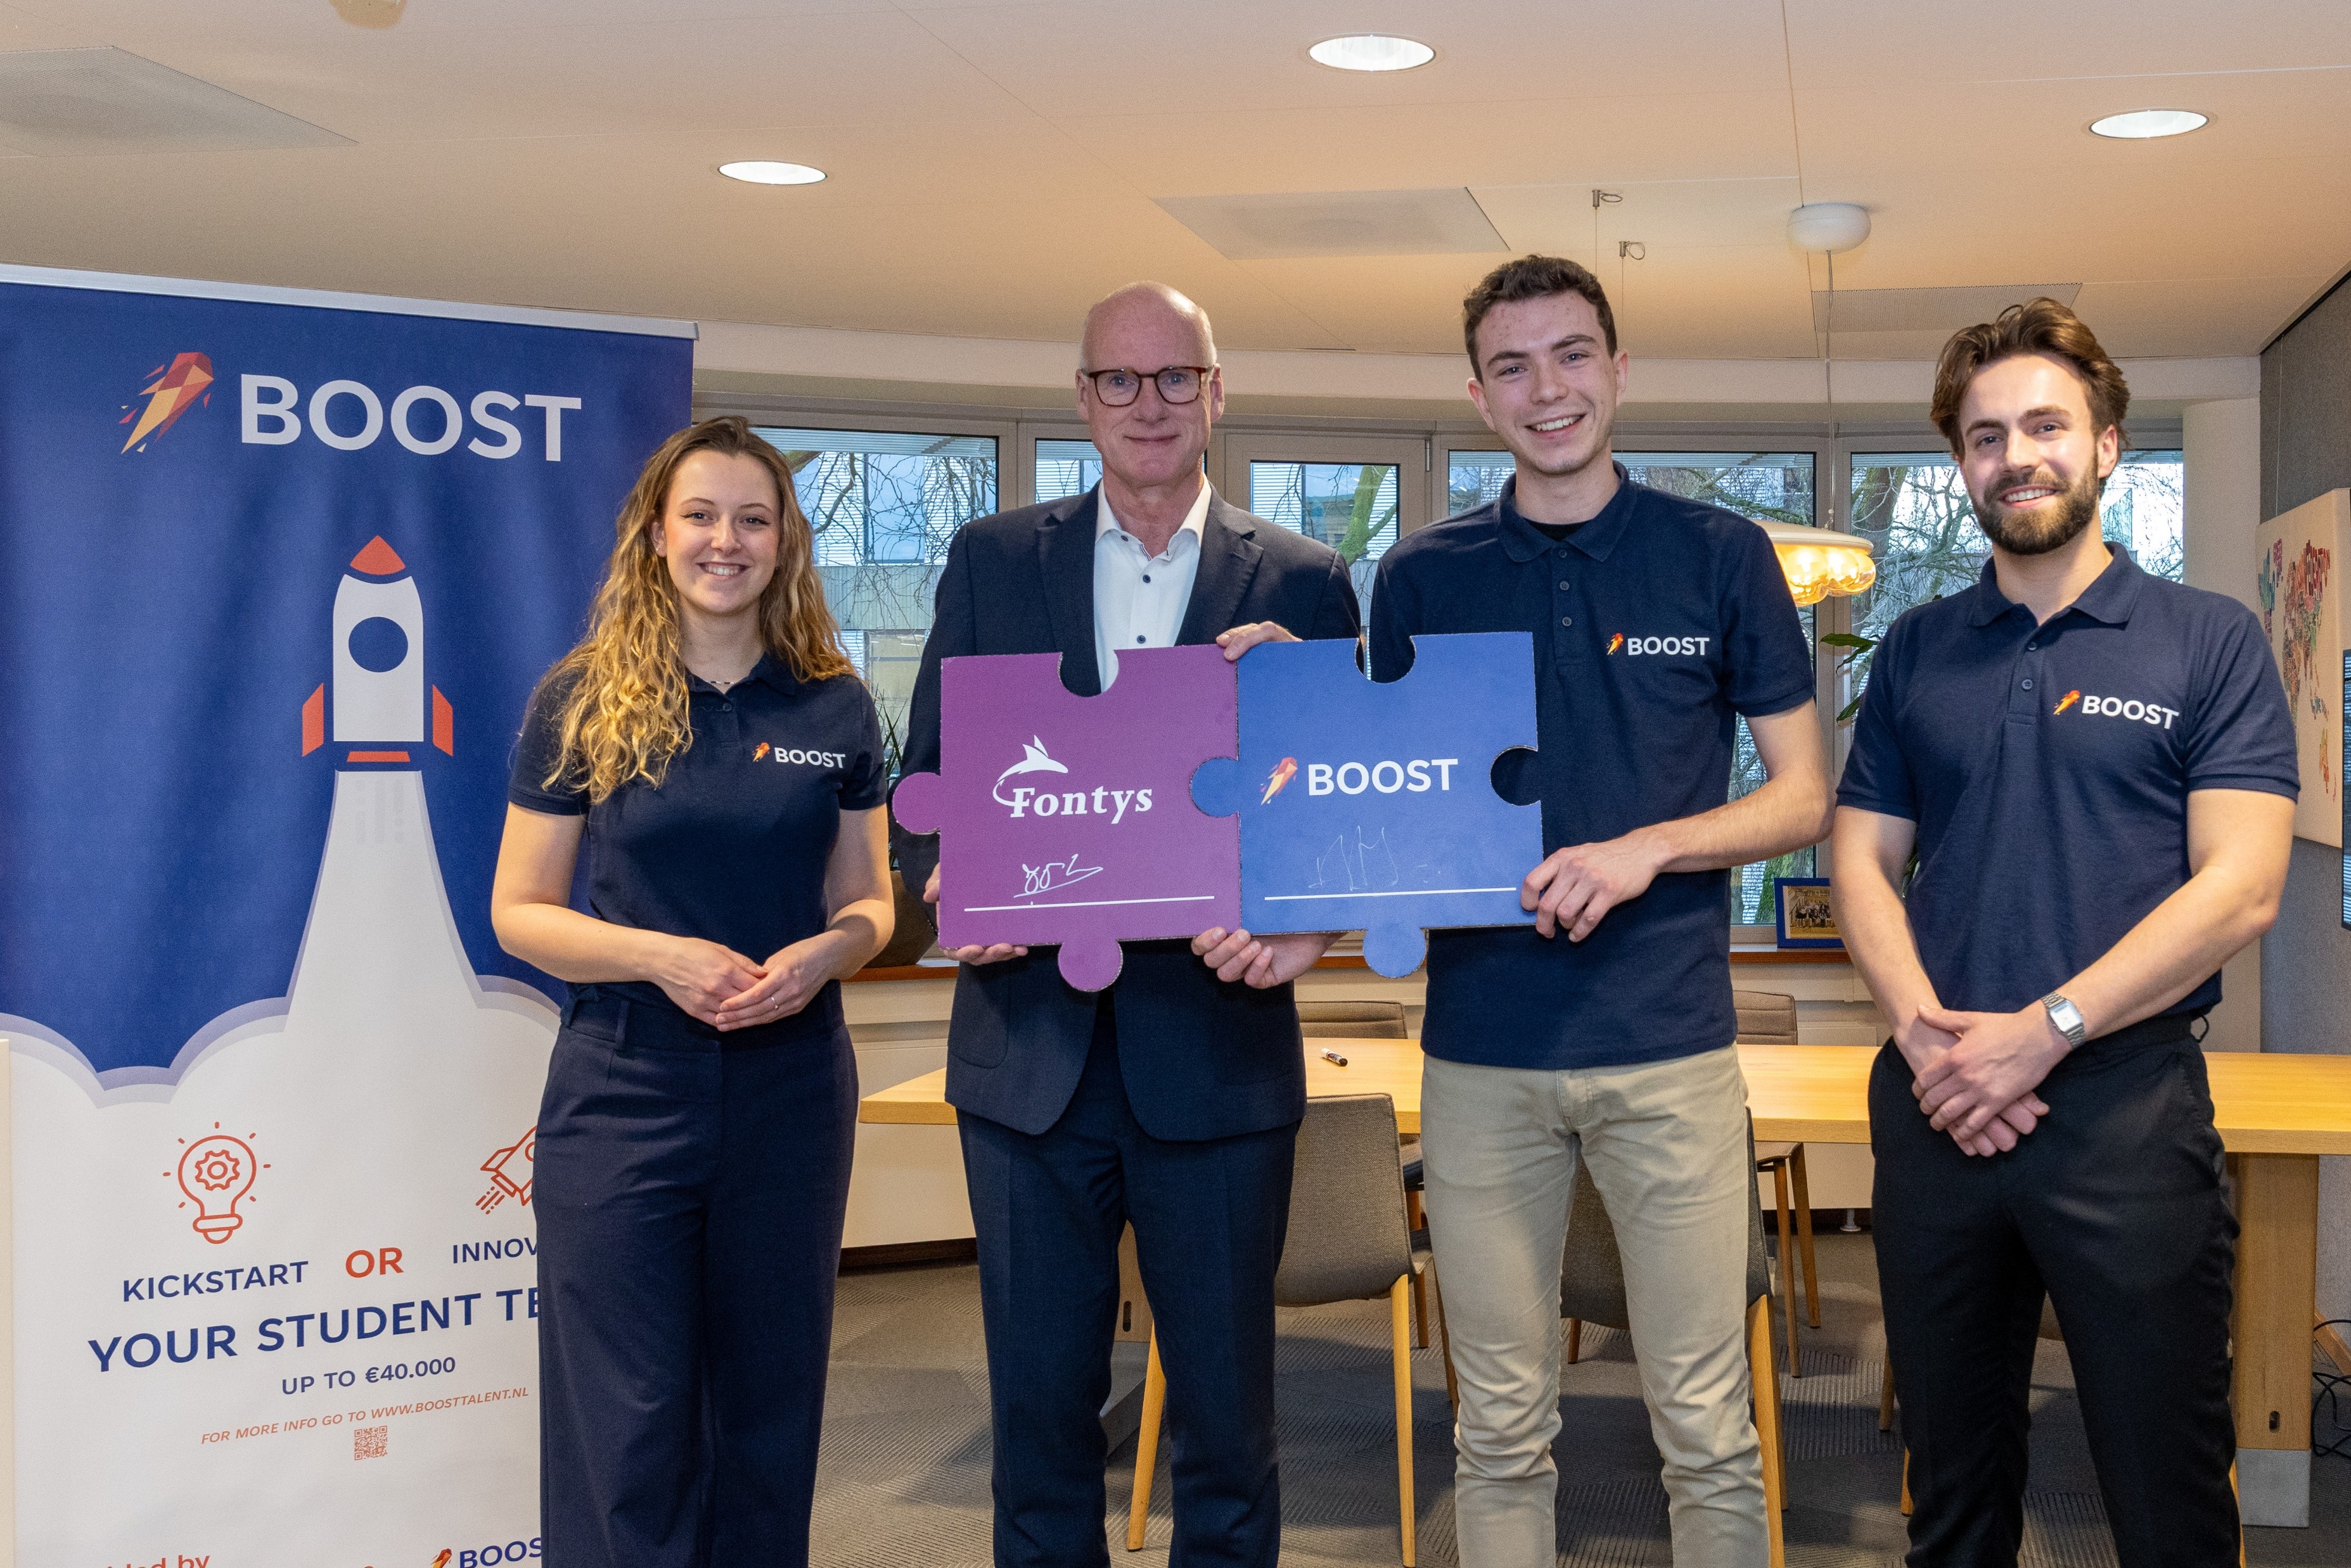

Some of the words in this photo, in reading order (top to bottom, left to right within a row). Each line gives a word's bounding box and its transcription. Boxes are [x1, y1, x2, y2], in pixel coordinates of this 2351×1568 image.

[241, 374, 581, 461] BOOST
[1628, 637, 1709, 655] BOOST
[2082, 696, 2179, 729] BOOST
[774, 748, 845, 768] BOOST
[1309, 759, 1458, 795] BOOST
[1010, 786, 1152, 824] Fontys
[124, 1261, 308, 1302] KICKSTART
[346, 1247, 403, 1278] OR
[454, 1238, 536, 1263] INNOV
[88, 1325, 237, 1372] YOUR
[258, 1293, 481, 1351] STUDENT
[496, 1287, 537, 1320] TE
[283, 1376, 314, 1394] UP
[324, 1370, 355, 1389] TO
[366, 1357, 455, 1383] €40.000
[202, 1431, 230, 1444] FOR
[236, 1424, 278, 1439] MORE
[284, 1418, 317, 1431] INFO
[322, 1414, 343, 1425] GO
[349, 1411, 366, 1422] TO
[371, 1387, 528, 1418] WWW.BOOSTTALENT.NL
[460, 1534, 541, 1568] BOOS
